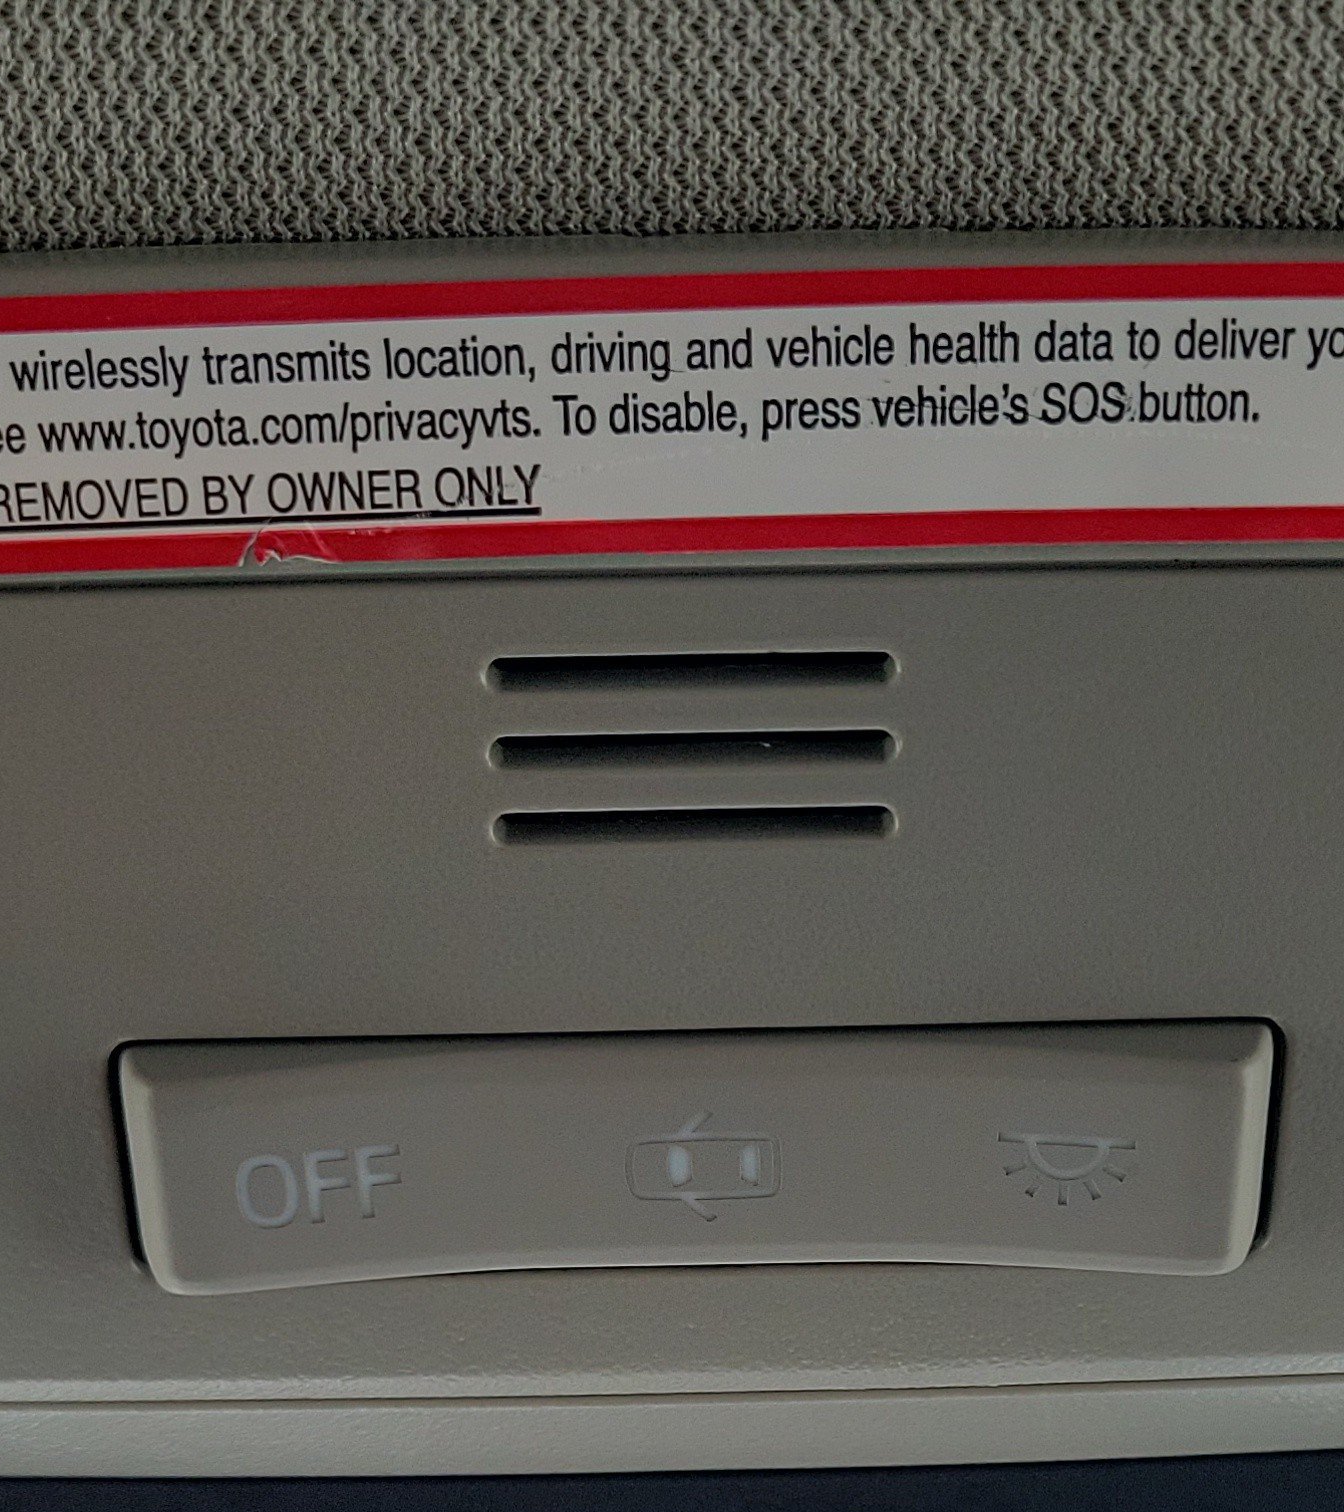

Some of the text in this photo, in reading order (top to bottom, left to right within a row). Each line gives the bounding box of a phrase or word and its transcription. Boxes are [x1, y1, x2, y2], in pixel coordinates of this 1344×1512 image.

[11, 346, 191, 397] wirelessly
[203, 341, 370, 385] transmits
[383, 337, 536, 382] location,
[550, 334, 673, 381] driving
[686, 330, 754, 371] and
[766, 325, 895, 368] vehicle
[909, 322, 1018, 364] health
[1034, 321, 1113, 363] data
[1127, 322, 1161, 362] to
[1172, 319, 1297, 361] deliver
[37, 402, 541, 457] www.toyota.com/privacyvts.
[553, 395, 598, 436] To
[609, 391, 750, 438] disable,
[761, 393, 861, 442] press
[1040, 383, 1129, 424] SOS
[1137, 383, 1261, 425] button.
[203, 471, 261, 517] BY
[268, 468, 423, 513] OWNER
[434, 464, 541, 508] ONLY
[233, 1140, 404, 1230] OFF
